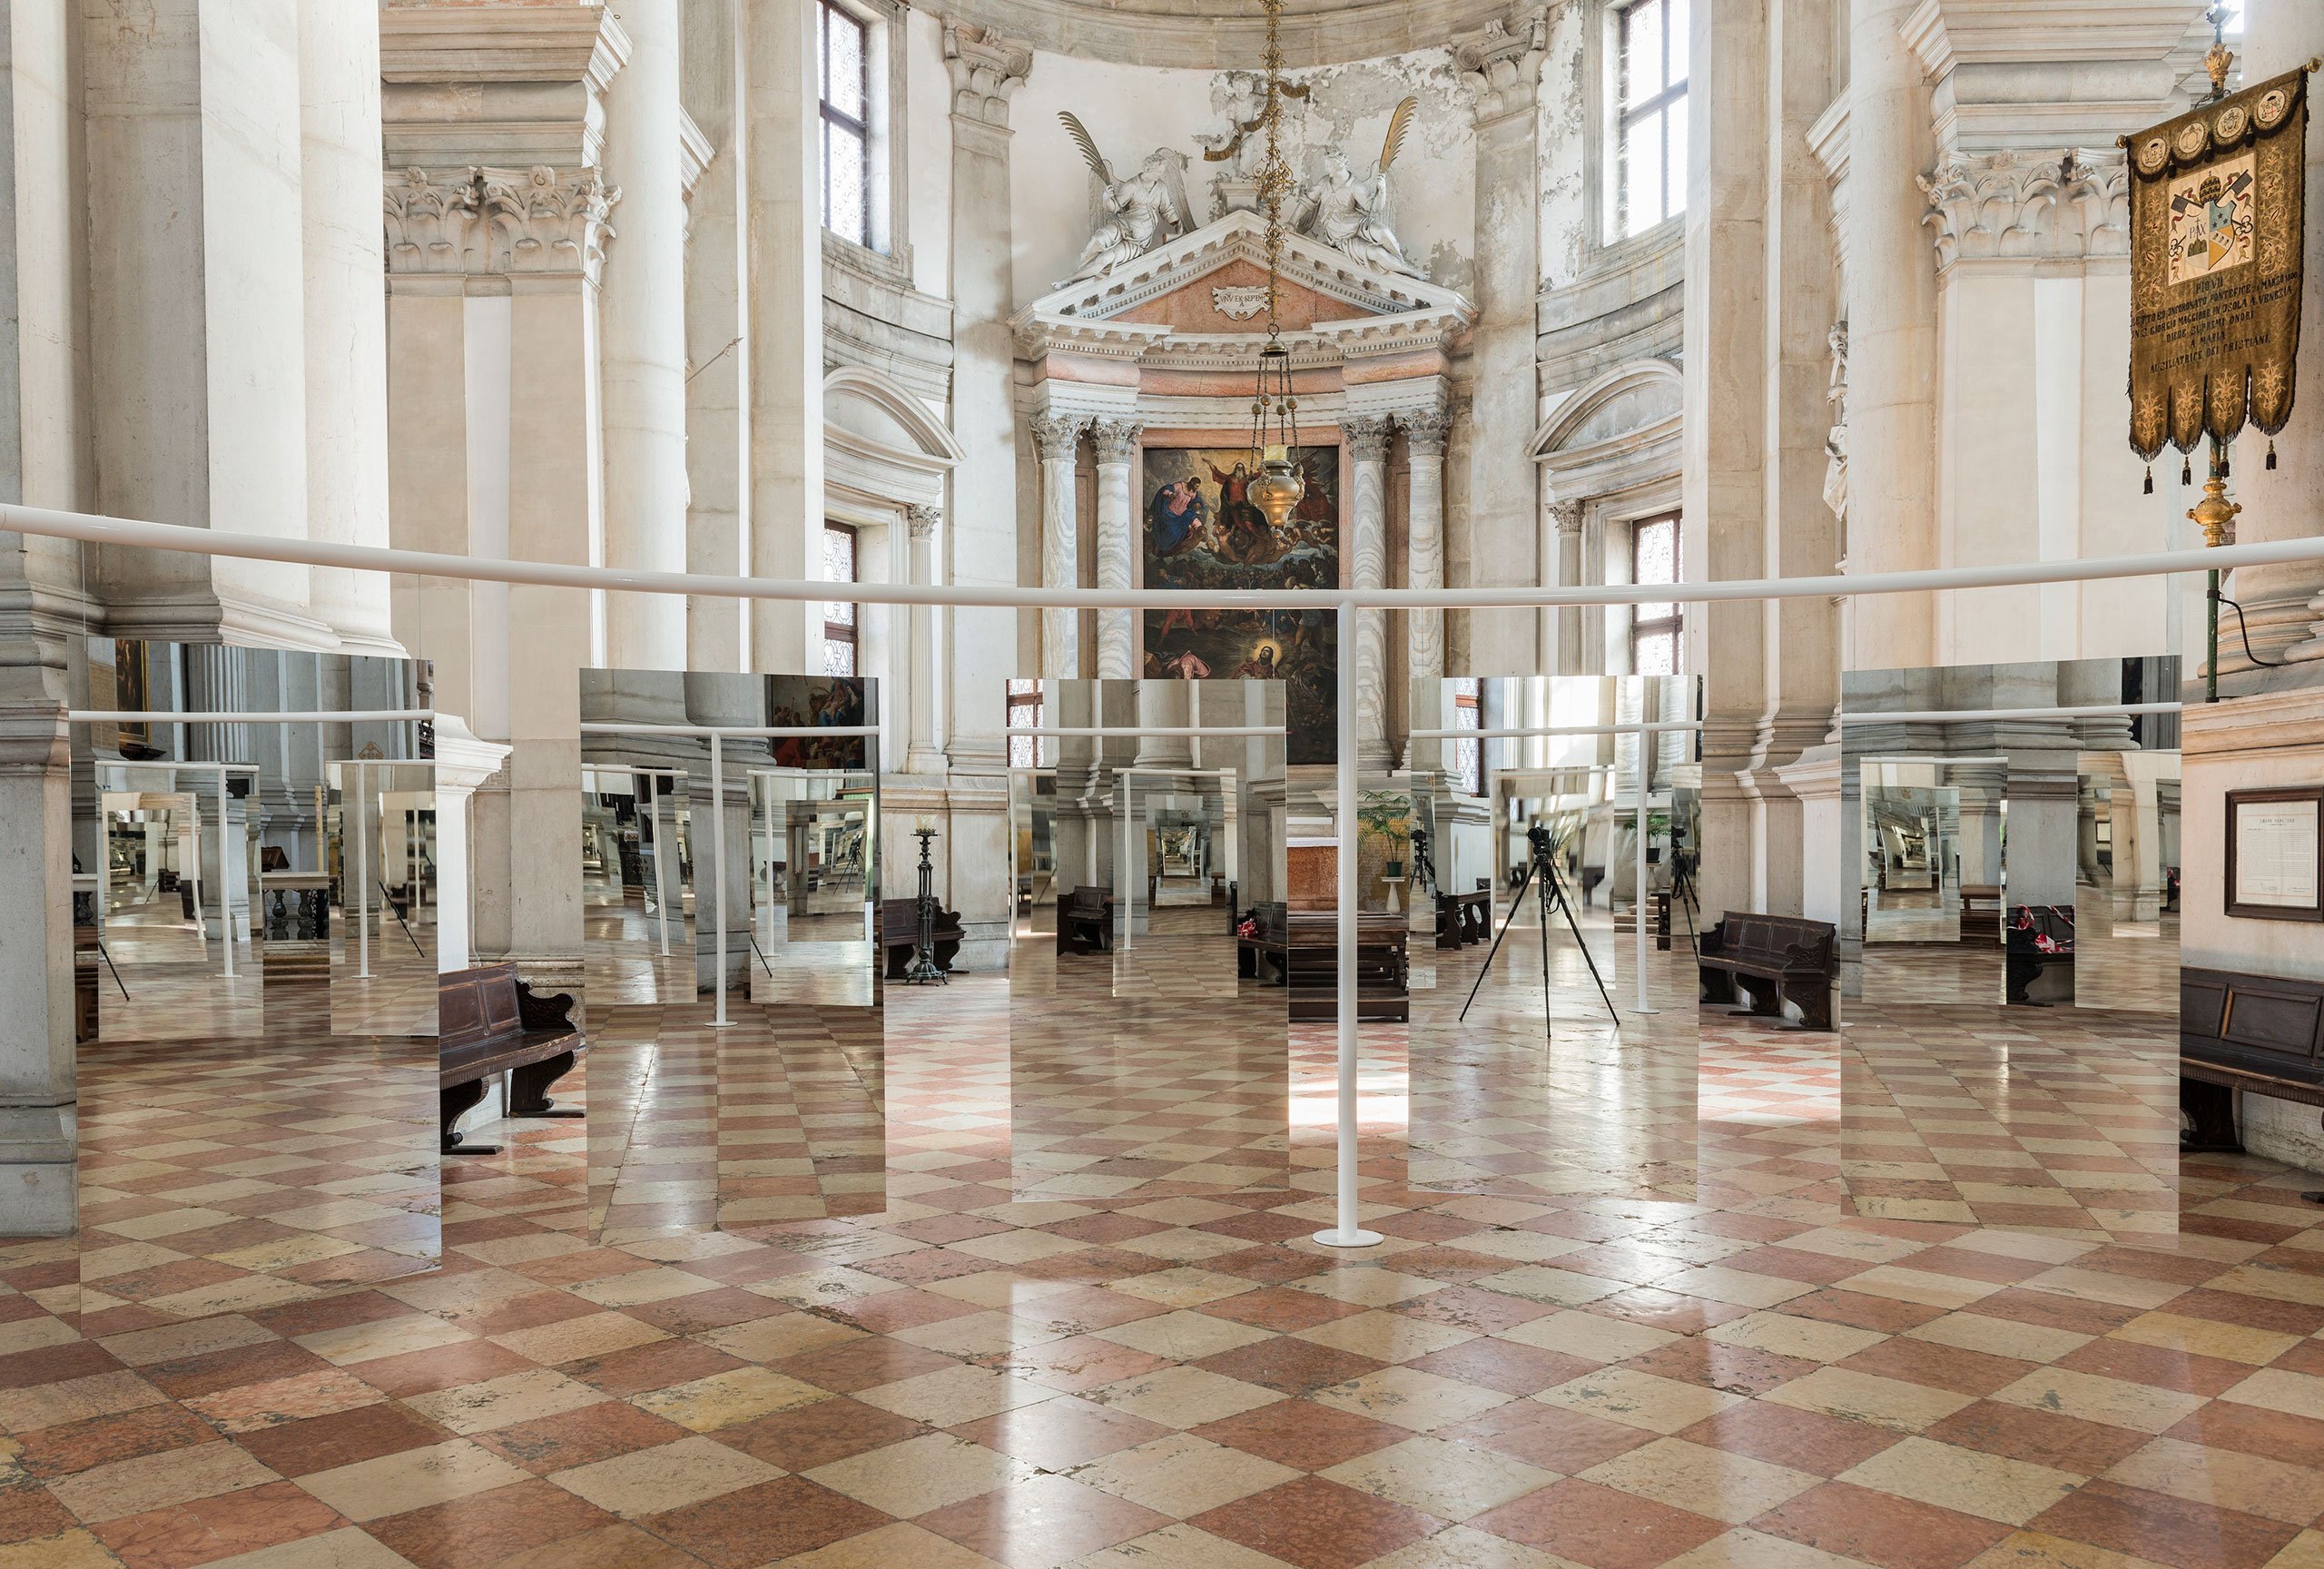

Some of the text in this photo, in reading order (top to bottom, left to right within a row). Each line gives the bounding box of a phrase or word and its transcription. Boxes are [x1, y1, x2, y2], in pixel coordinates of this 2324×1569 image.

[2189, 222, 2207, 239] PAX
[2261, 274, 2284, 290] MARZO
[2150, 319, 2176, 335] GIORGIO
[2178, 309, 2211, 325] MAGGIORE
[2250, 297, 2256, 307] A
[2258, 285, 2292, 305] VENEZIA
[2166, 310, 2254, 343] DIEDE SUPREMI ONORI
[2191, 331, 2226, 349] A MARIA
[2150, 350, 2203, 374] AUSILIATRICE
[2206, 346, 2219, 358] DEI
